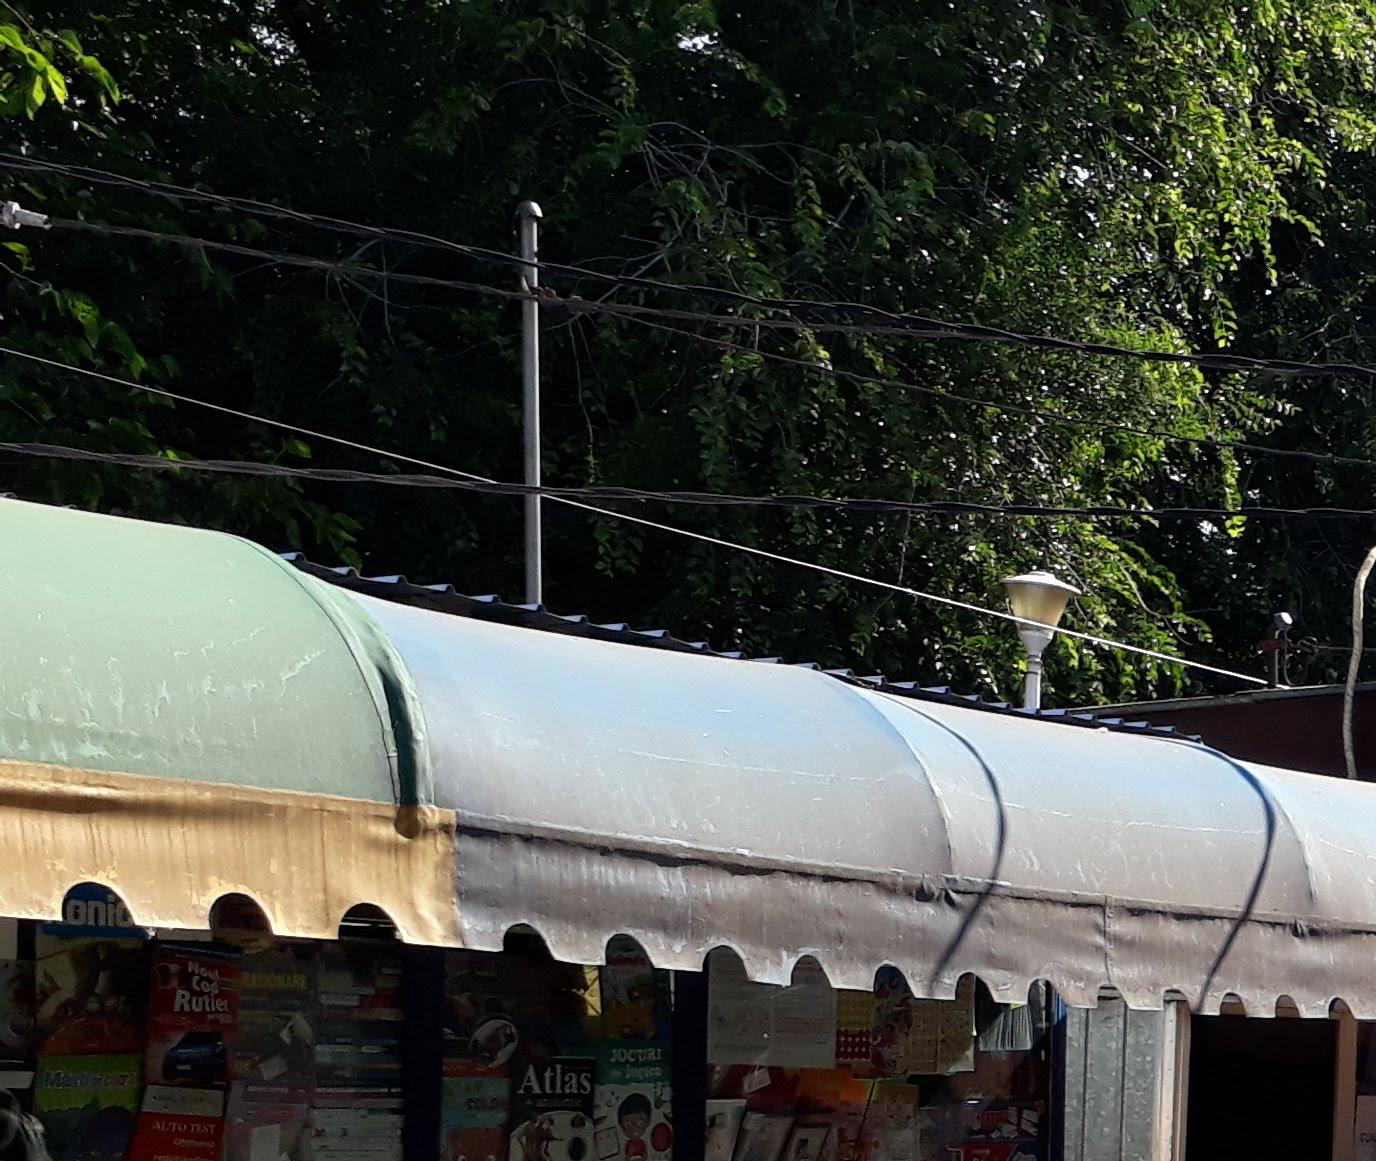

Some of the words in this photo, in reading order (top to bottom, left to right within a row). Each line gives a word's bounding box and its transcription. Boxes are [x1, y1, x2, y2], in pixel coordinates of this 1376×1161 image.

[516, 1063, 593, 1095] Atlas
[151, 1120, 188, 1133] AUTO
[191, 1122, 218, 1135] TEST
